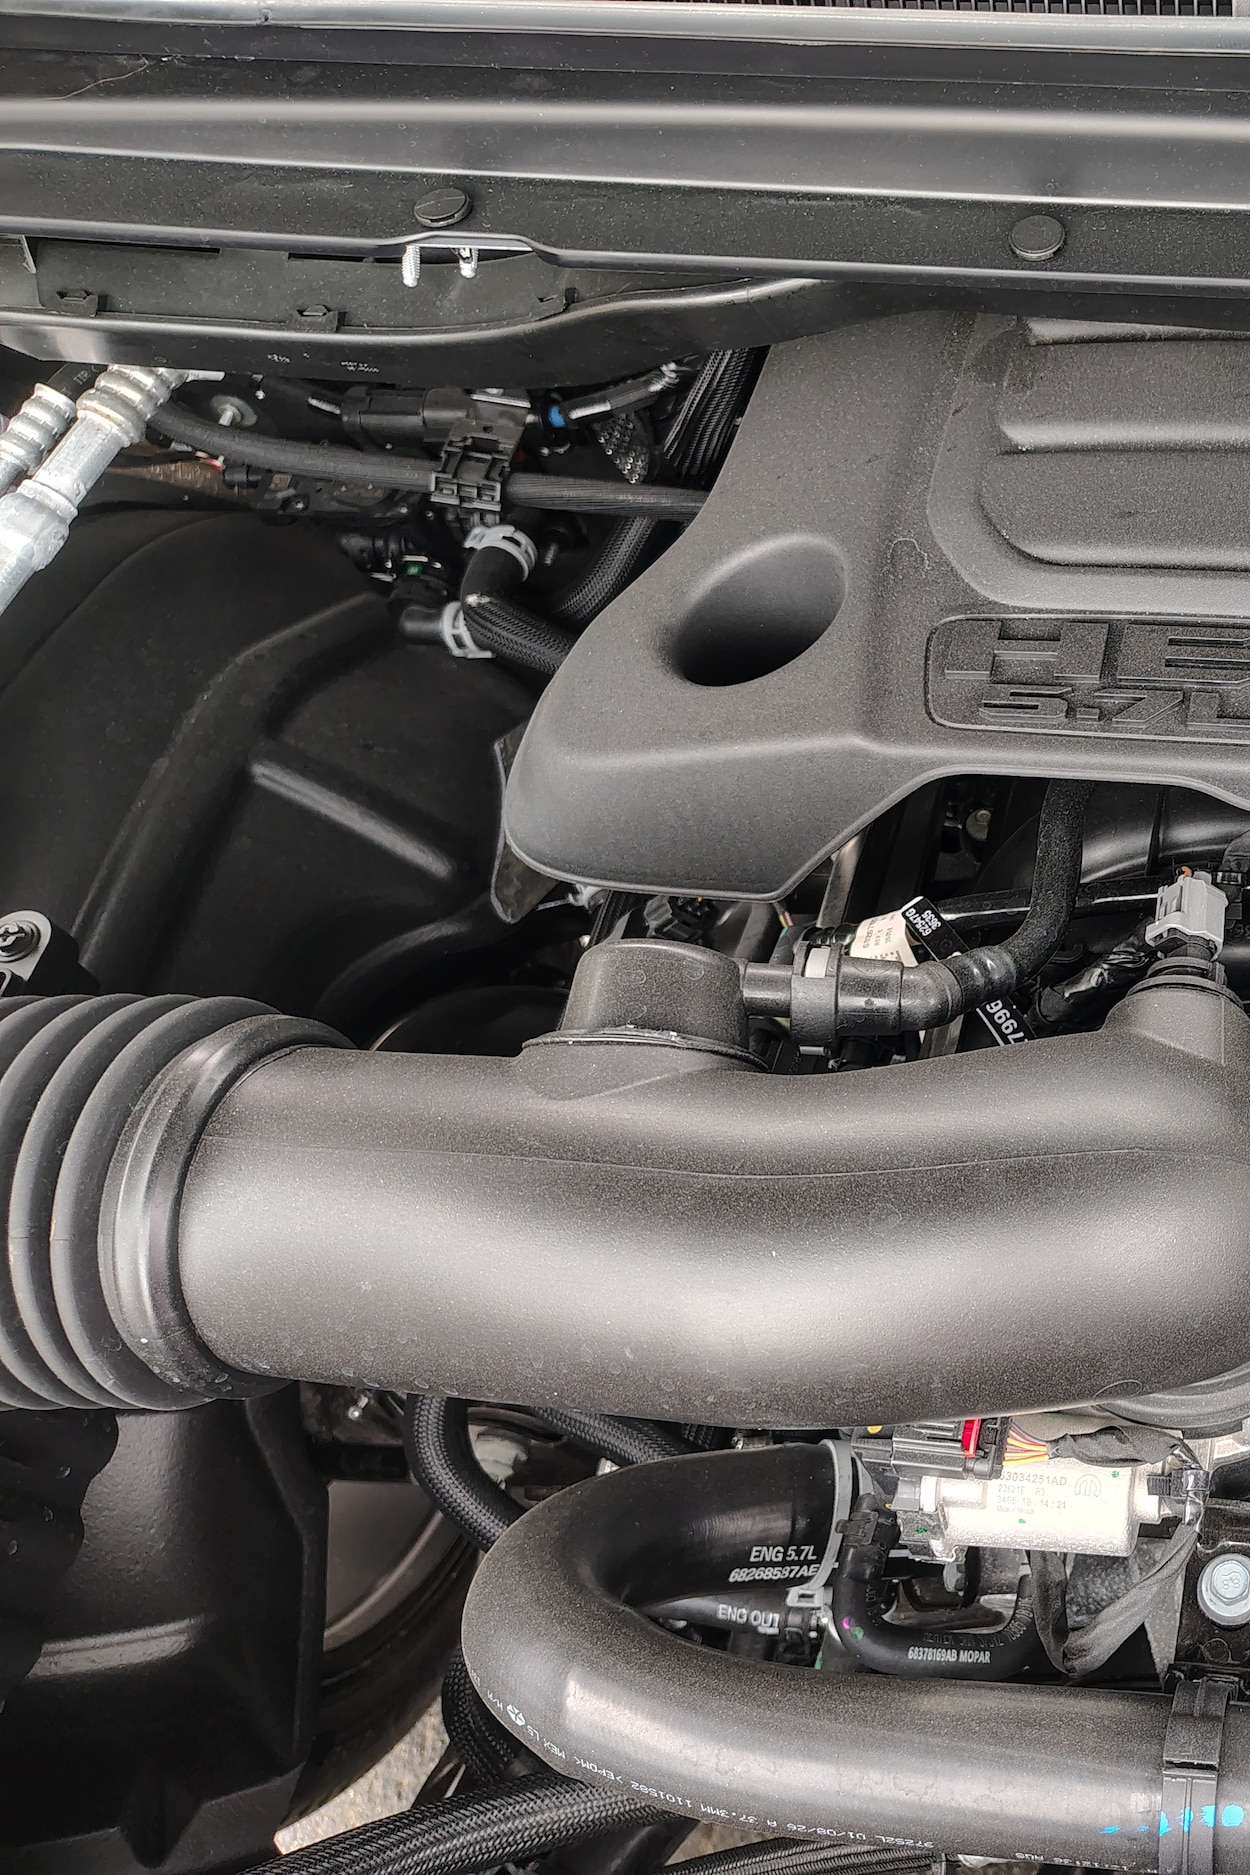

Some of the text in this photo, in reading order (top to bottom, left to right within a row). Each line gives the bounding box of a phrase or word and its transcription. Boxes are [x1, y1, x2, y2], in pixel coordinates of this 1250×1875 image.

[905, 907, 932, 937] 62547G
[986, 1000, 1028, 1044] 7996
[750, 1545, 817, 1562] ENG 5.7L
[717, 1604, 748, 1623] ENG
[908, 1646, 991, 1663] 68378169AB MOPAR
